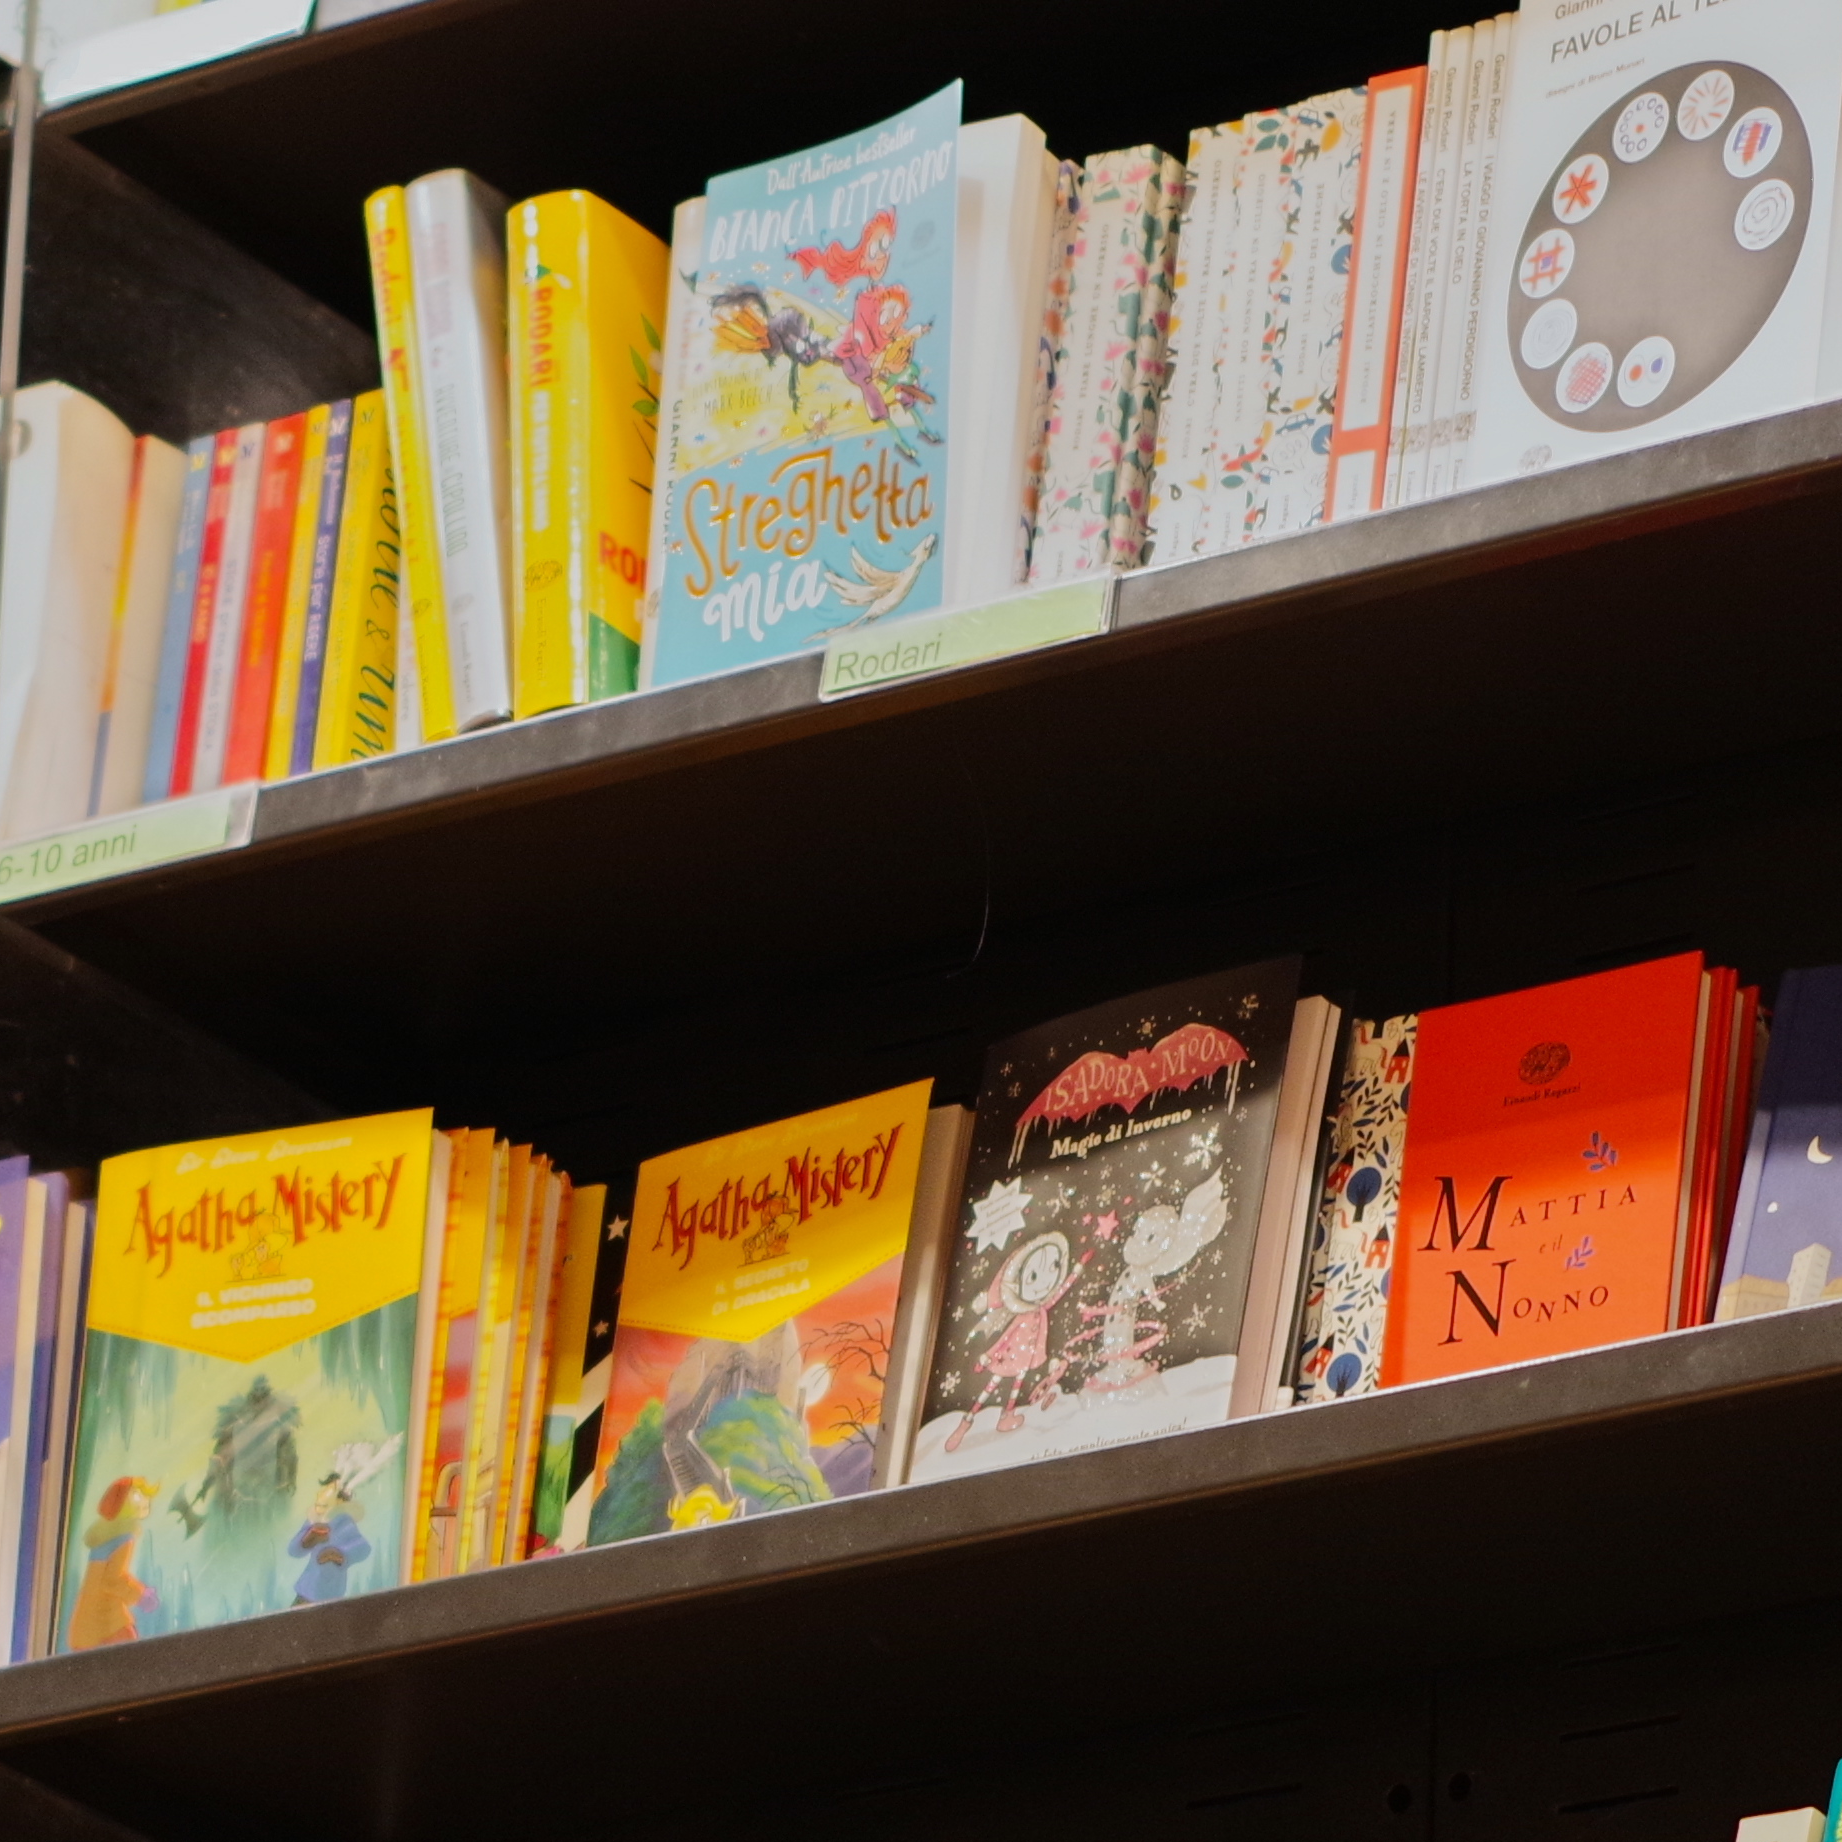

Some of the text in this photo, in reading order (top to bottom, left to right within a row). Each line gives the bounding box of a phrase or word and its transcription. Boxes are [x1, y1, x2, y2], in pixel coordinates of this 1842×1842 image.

[1551, 12, 1643, 63] FAVOLE
[856, 127, 917, 166] bestseller
[710, 141, 953, 263] BIANCA PITZORNO
[1460, 163, 1492, 400] VIAGGI DI GIOVANNINO PERDIGIORNO
[684, 446, 932, 599] Streghetta
[704, 558, 828, 642] mia
[833, 634, 943, 685] Rodari
[70, 824, 137, 871] anni
[1043, 1031, 1234, 1113] ISADORA MOON
[1049, 1107, 1192, 1160] Magie di Inverno
[124, 1184, 257, 1279] Agatha
[273, 1152, 409, 1241] Mistery
[652, 1173, 779, 1272] Agatha
[788, 1123, 905, 1202] Mistery
[1417, 1175, 1638, 1252] MATTIA
[1436, 1261, 1610, 1344] NONNO
